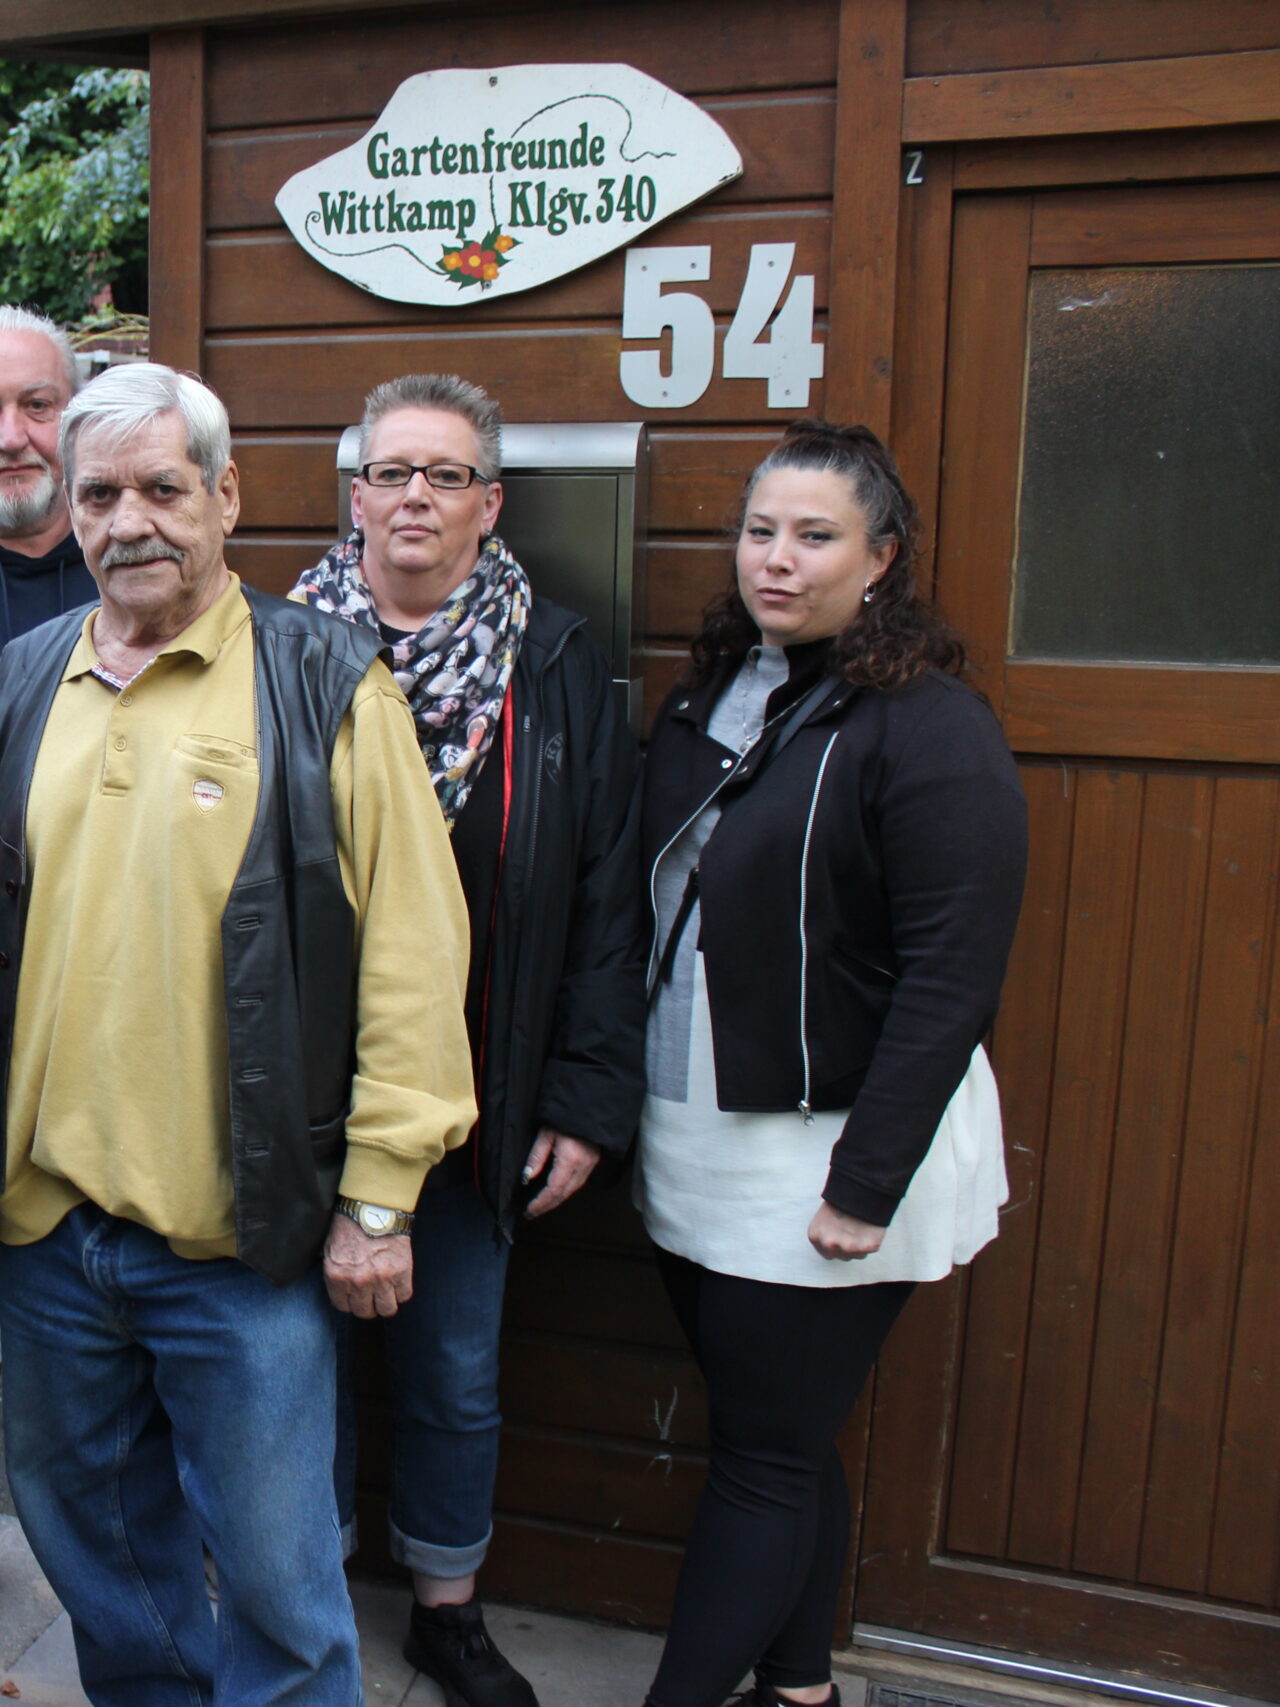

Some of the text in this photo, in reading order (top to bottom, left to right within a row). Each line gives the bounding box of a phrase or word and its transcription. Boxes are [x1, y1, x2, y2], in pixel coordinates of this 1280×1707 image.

[367, 122, 604, 179] Gartenfreunde
[318, 190, 475, 239] Wittkamp
[619, 241, 824, 408] 54
